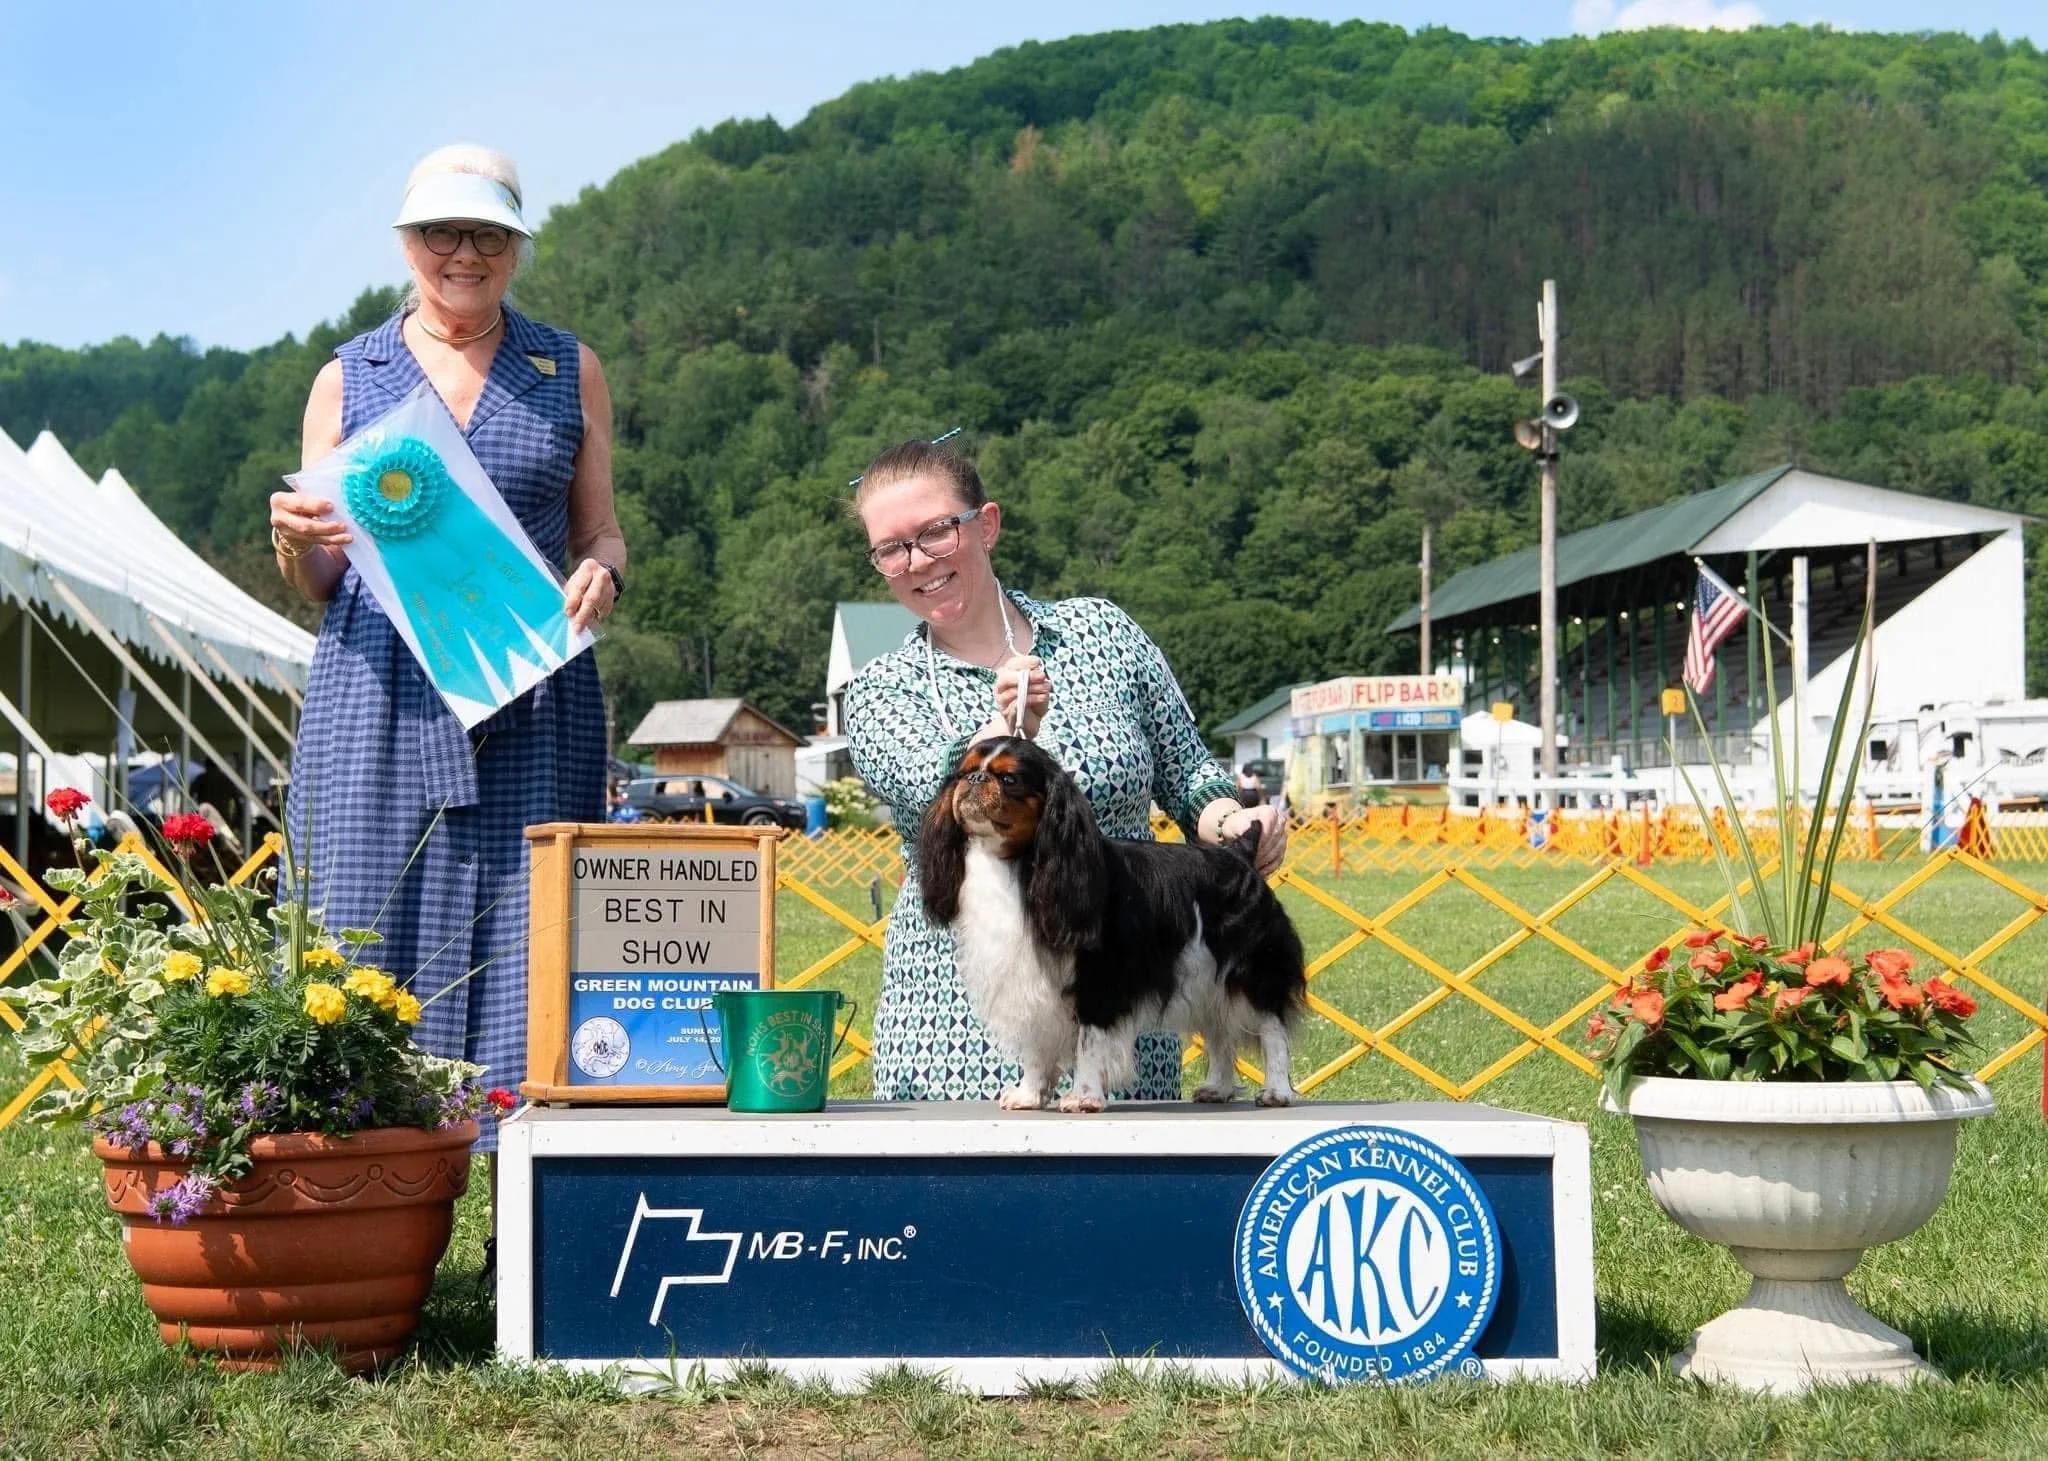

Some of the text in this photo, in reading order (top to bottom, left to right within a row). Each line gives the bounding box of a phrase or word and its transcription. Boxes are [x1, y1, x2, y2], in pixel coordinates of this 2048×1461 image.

[1355, 682, 1395, 703] FLIP
[1400, 681, 1440, 703] BAR
[574, 857, 757, 882] OWNER HANDLED
[604, 898, 726, 924] BEST IN
[622, 939, 711, 965] SHOW
[574, 979, 753, 992] GREEN MOUNTAIN
[613, 997, 714, 1010] DOG CLUB
[767, 1010, 799, 1027] BEST
[800, 1011, 813, 1025] IN
[667, 1036, 690, 1044] JULY
[1257, 1147, 1479, 1280] AMERICAN KENNEL CLUB
[1297, 1185, 1440, 1341] AKC
[1292, 1331, 1447, 1374] FOUNDED 1884
